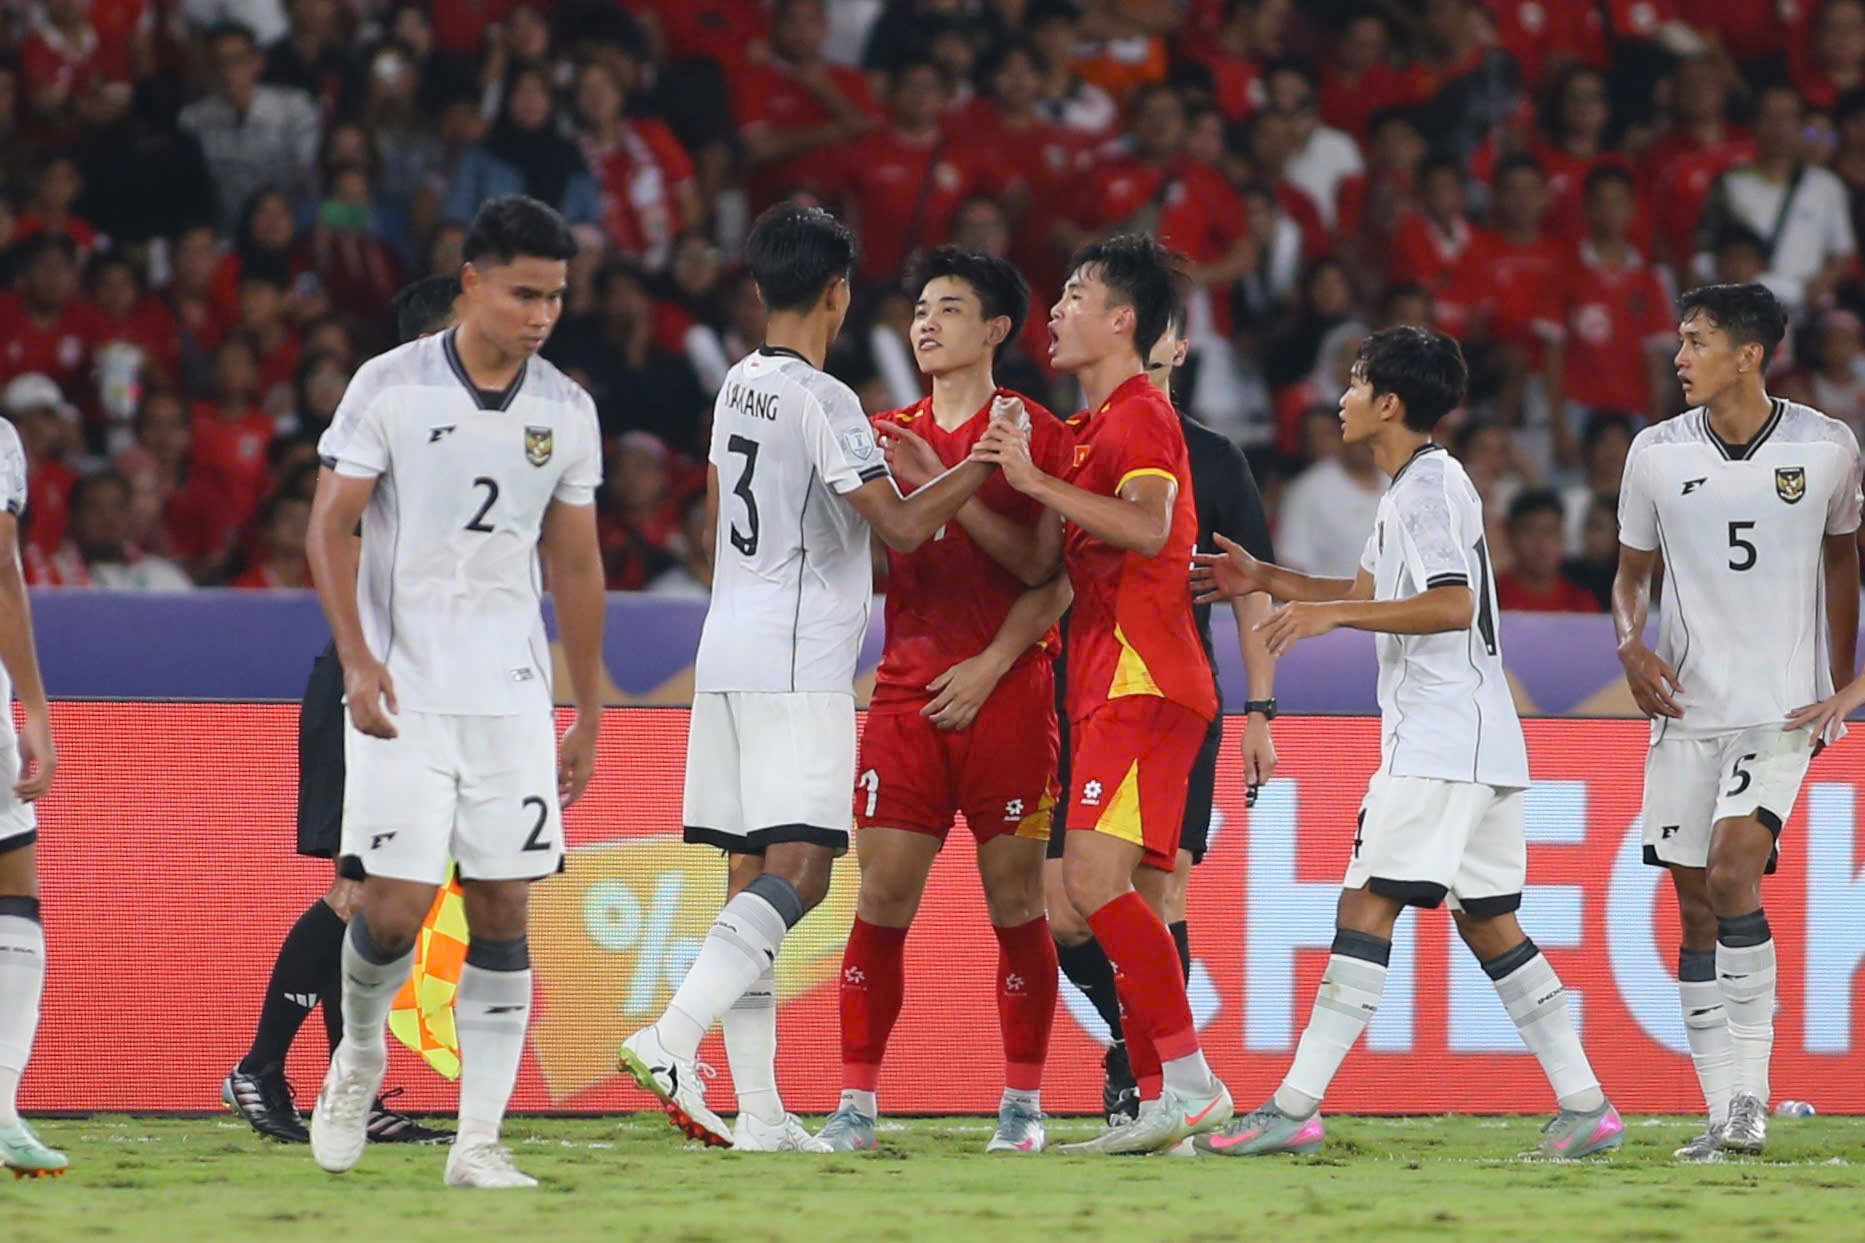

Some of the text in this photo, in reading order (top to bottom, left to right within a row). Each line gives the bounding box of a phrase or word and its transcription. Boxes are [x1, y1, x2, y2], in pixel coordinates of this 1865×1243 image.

[464, 476, 499, 533] 2
[727, 433, 761, 557] 3
[1728, 520, 1758, 582] 5
[1726, 752, 1758, 798] 5
[520, 795, 552, 852] 2
